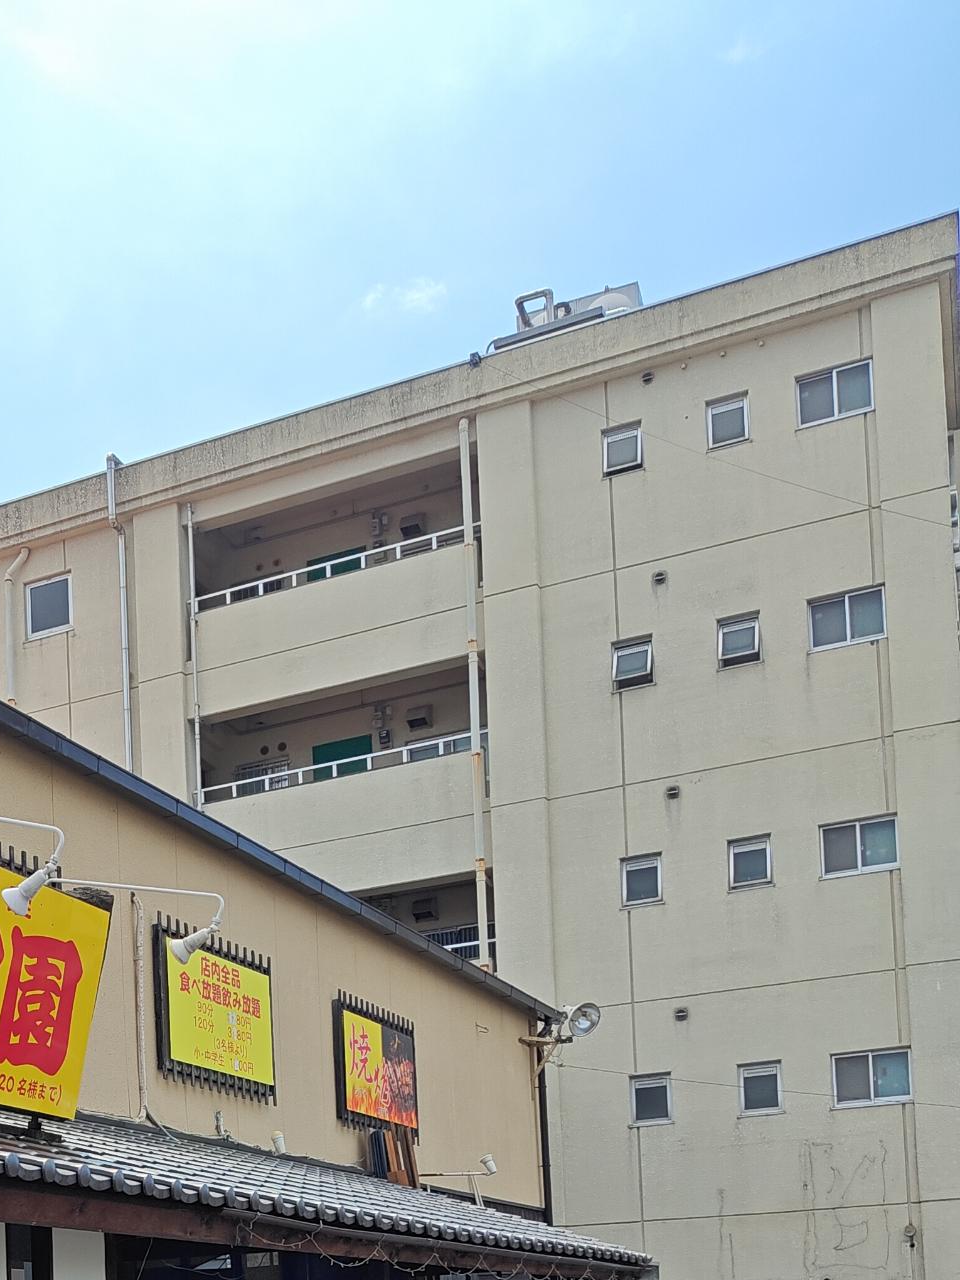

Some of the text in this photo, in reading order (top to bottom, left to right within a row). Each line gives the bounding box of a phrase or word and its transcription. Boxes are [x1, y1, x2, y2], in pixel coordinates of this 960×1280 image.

[200, 956, 241, 989] 店内全品
[179, 971, 262, 1019] 食べ放題飲み放題
[227, 1026, 253, 1046] 380円
[229, 1057, 254, 1076] 100円
